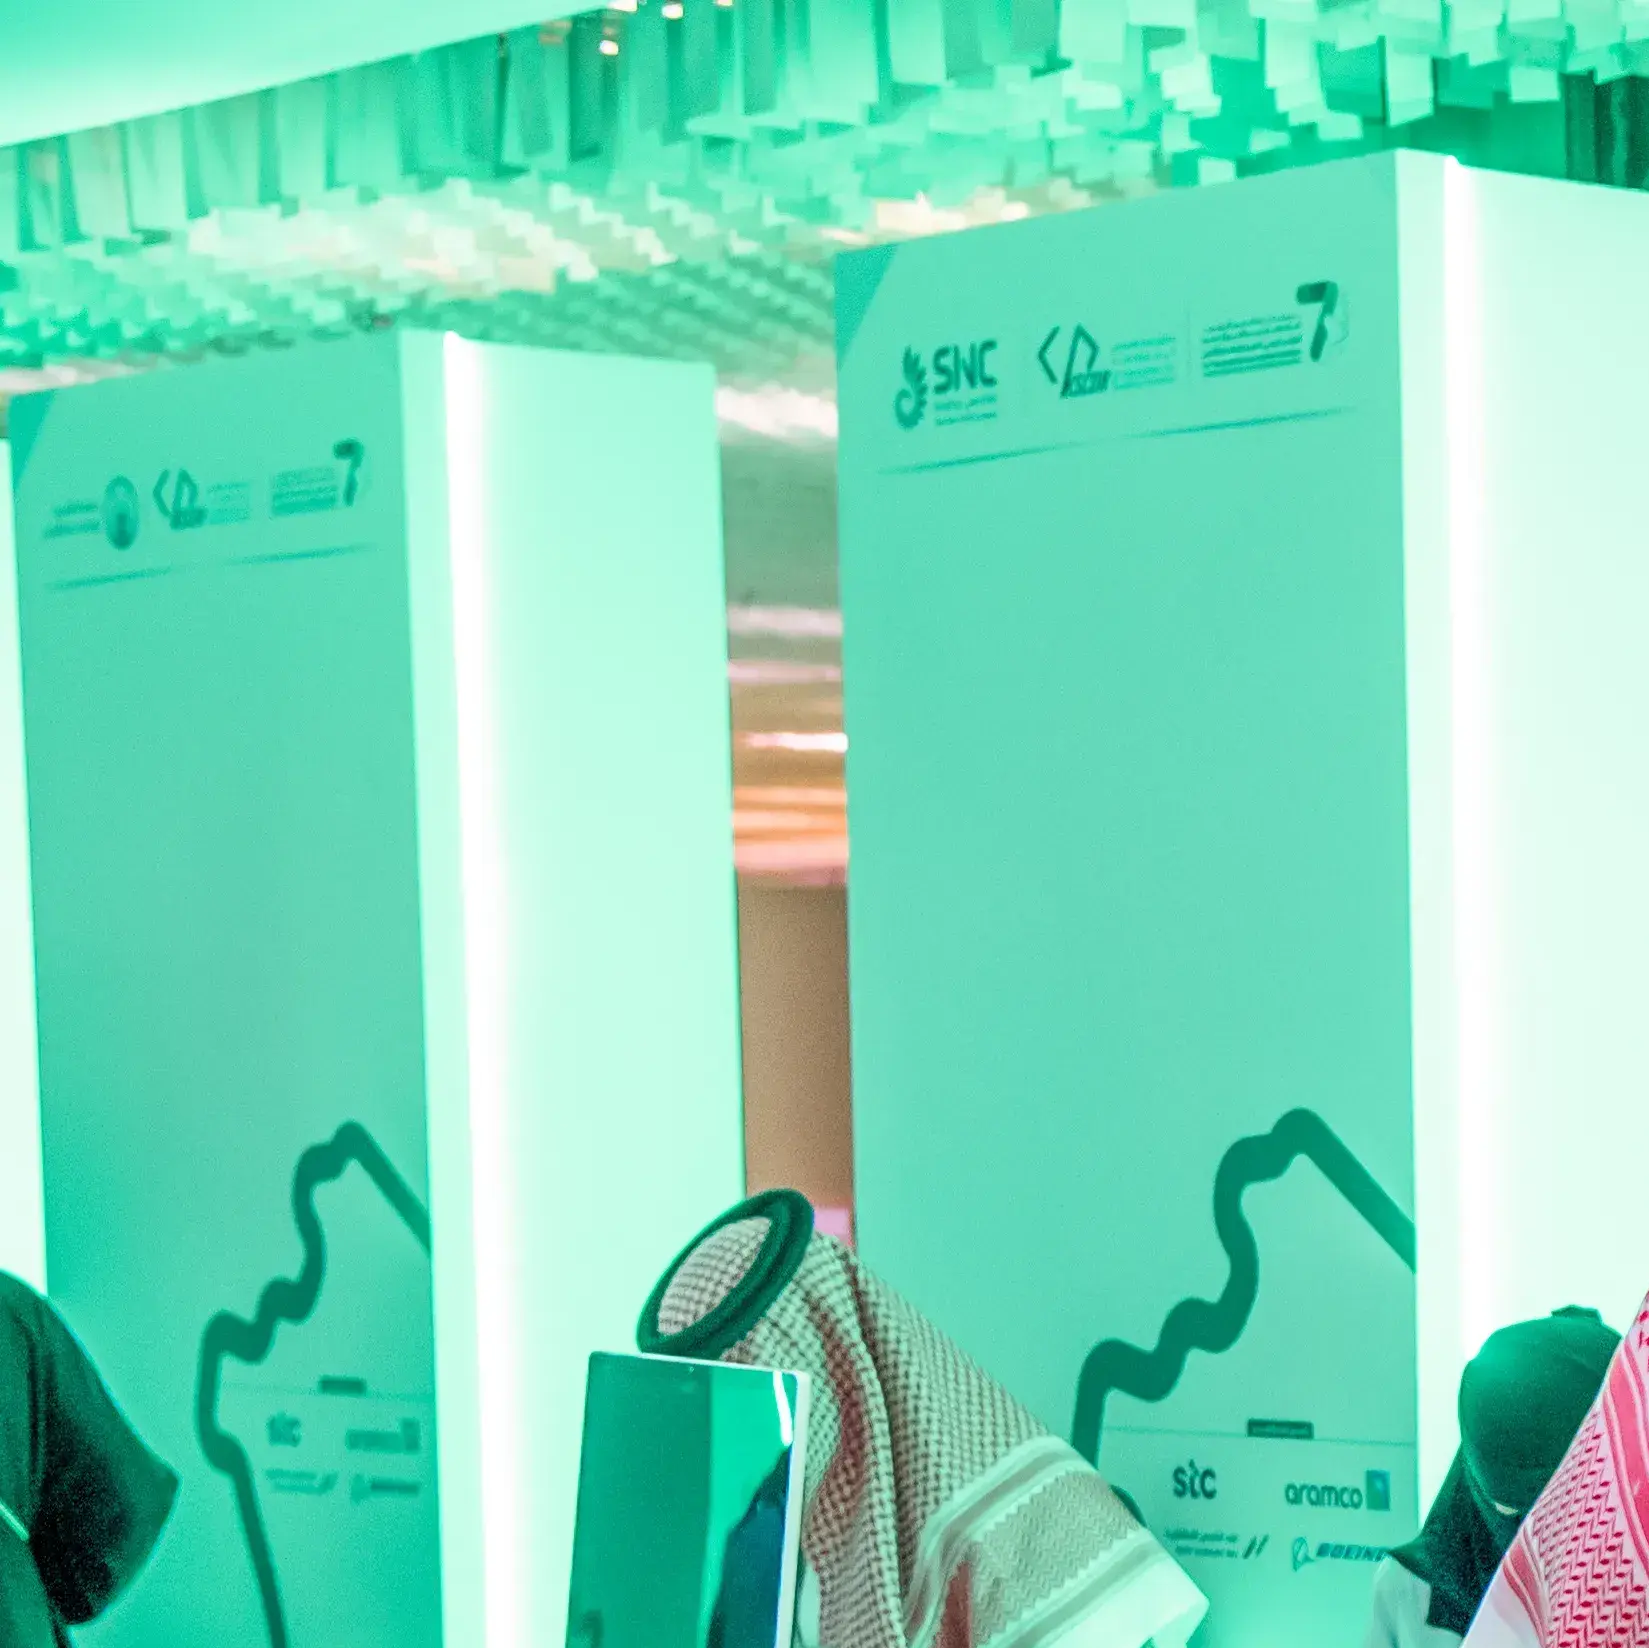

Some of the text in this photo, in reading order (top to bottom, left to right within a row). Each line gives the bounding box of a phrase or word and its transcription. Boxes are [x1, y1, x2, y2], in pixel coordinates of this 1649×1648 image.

[932, 338, 999, 394] SNC
[1172, 1459, 1217, 1500] stc
[1284, 1483, 1363, 1510] aramco
